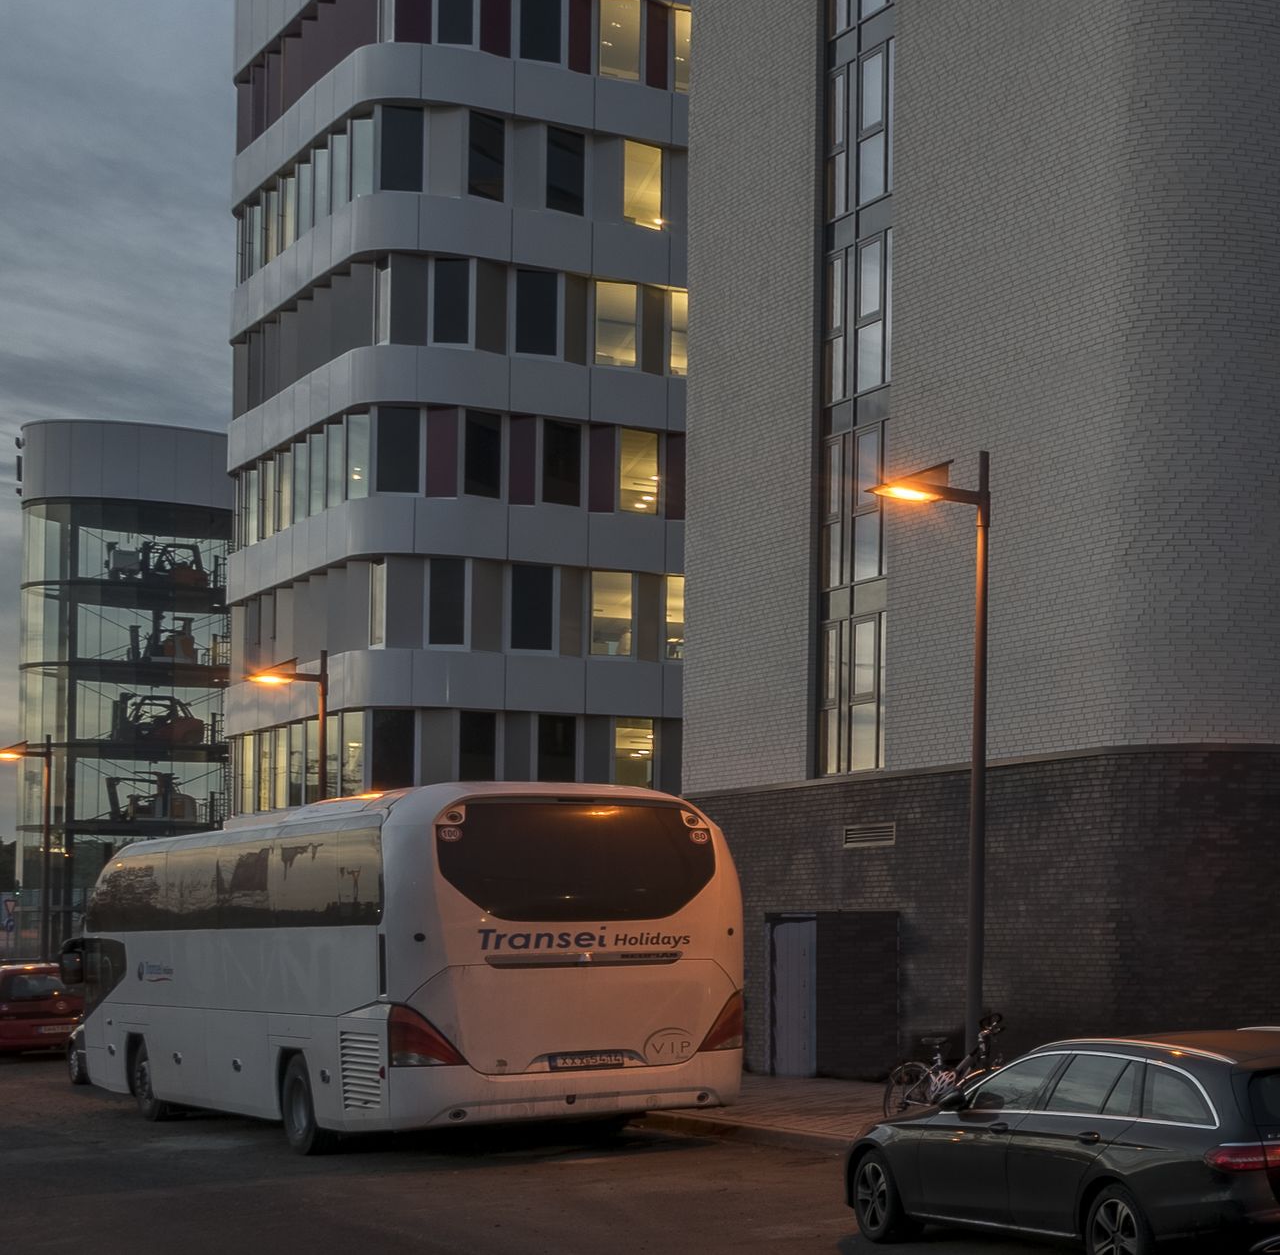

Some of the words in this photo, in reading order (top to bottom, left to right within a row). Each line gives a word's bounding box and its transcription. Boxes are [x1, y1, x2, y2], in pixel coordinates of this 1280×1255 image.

[694, 832, 706, 841] 80
[478, 927, 607, 950] Transei
[614, 932, 691, 949] Holidays
